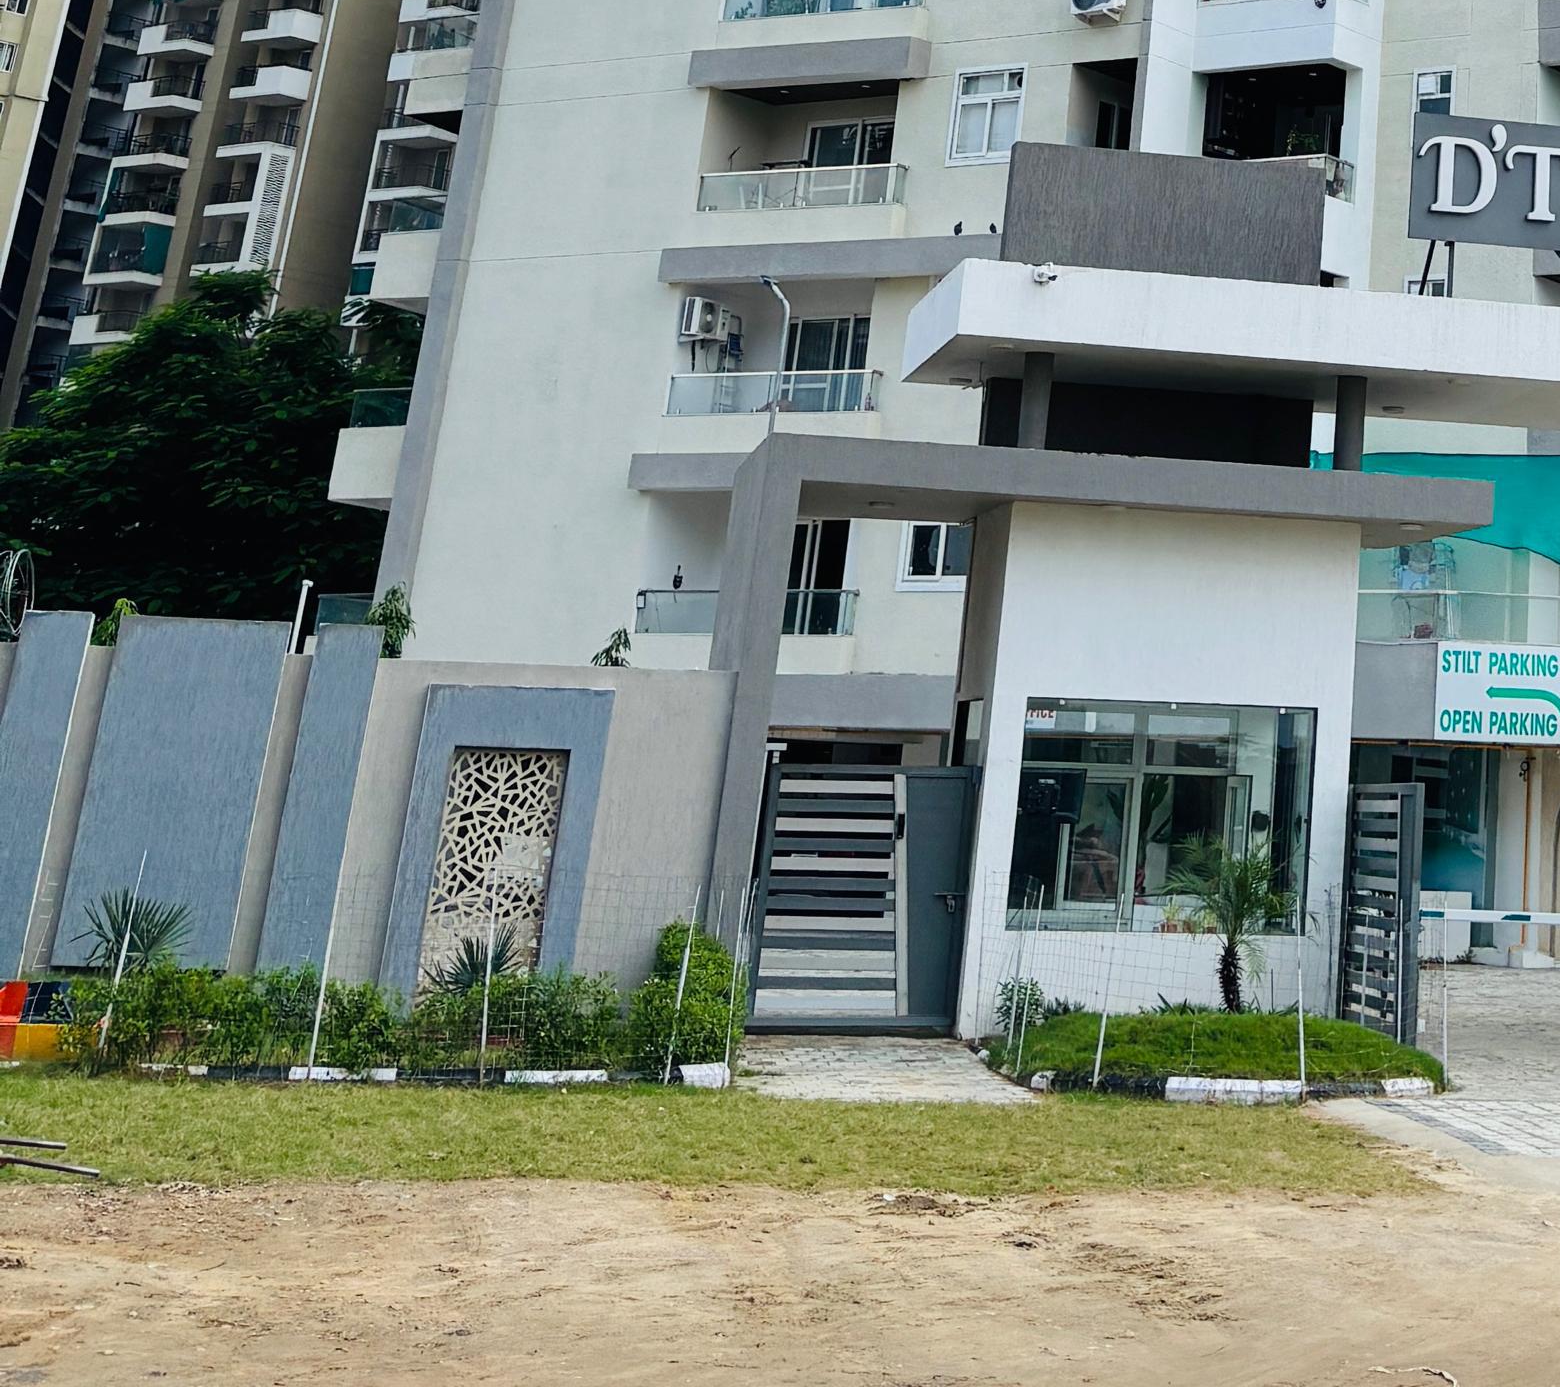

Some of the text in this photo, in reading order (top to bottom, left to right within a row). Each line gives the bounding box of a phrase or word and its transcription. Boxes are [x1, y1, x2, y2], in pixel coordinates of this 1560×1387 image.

[1441, 649, 1559, 678] STILT PARKING
[1440, 709, 1558, 737] OPEN PARKING
